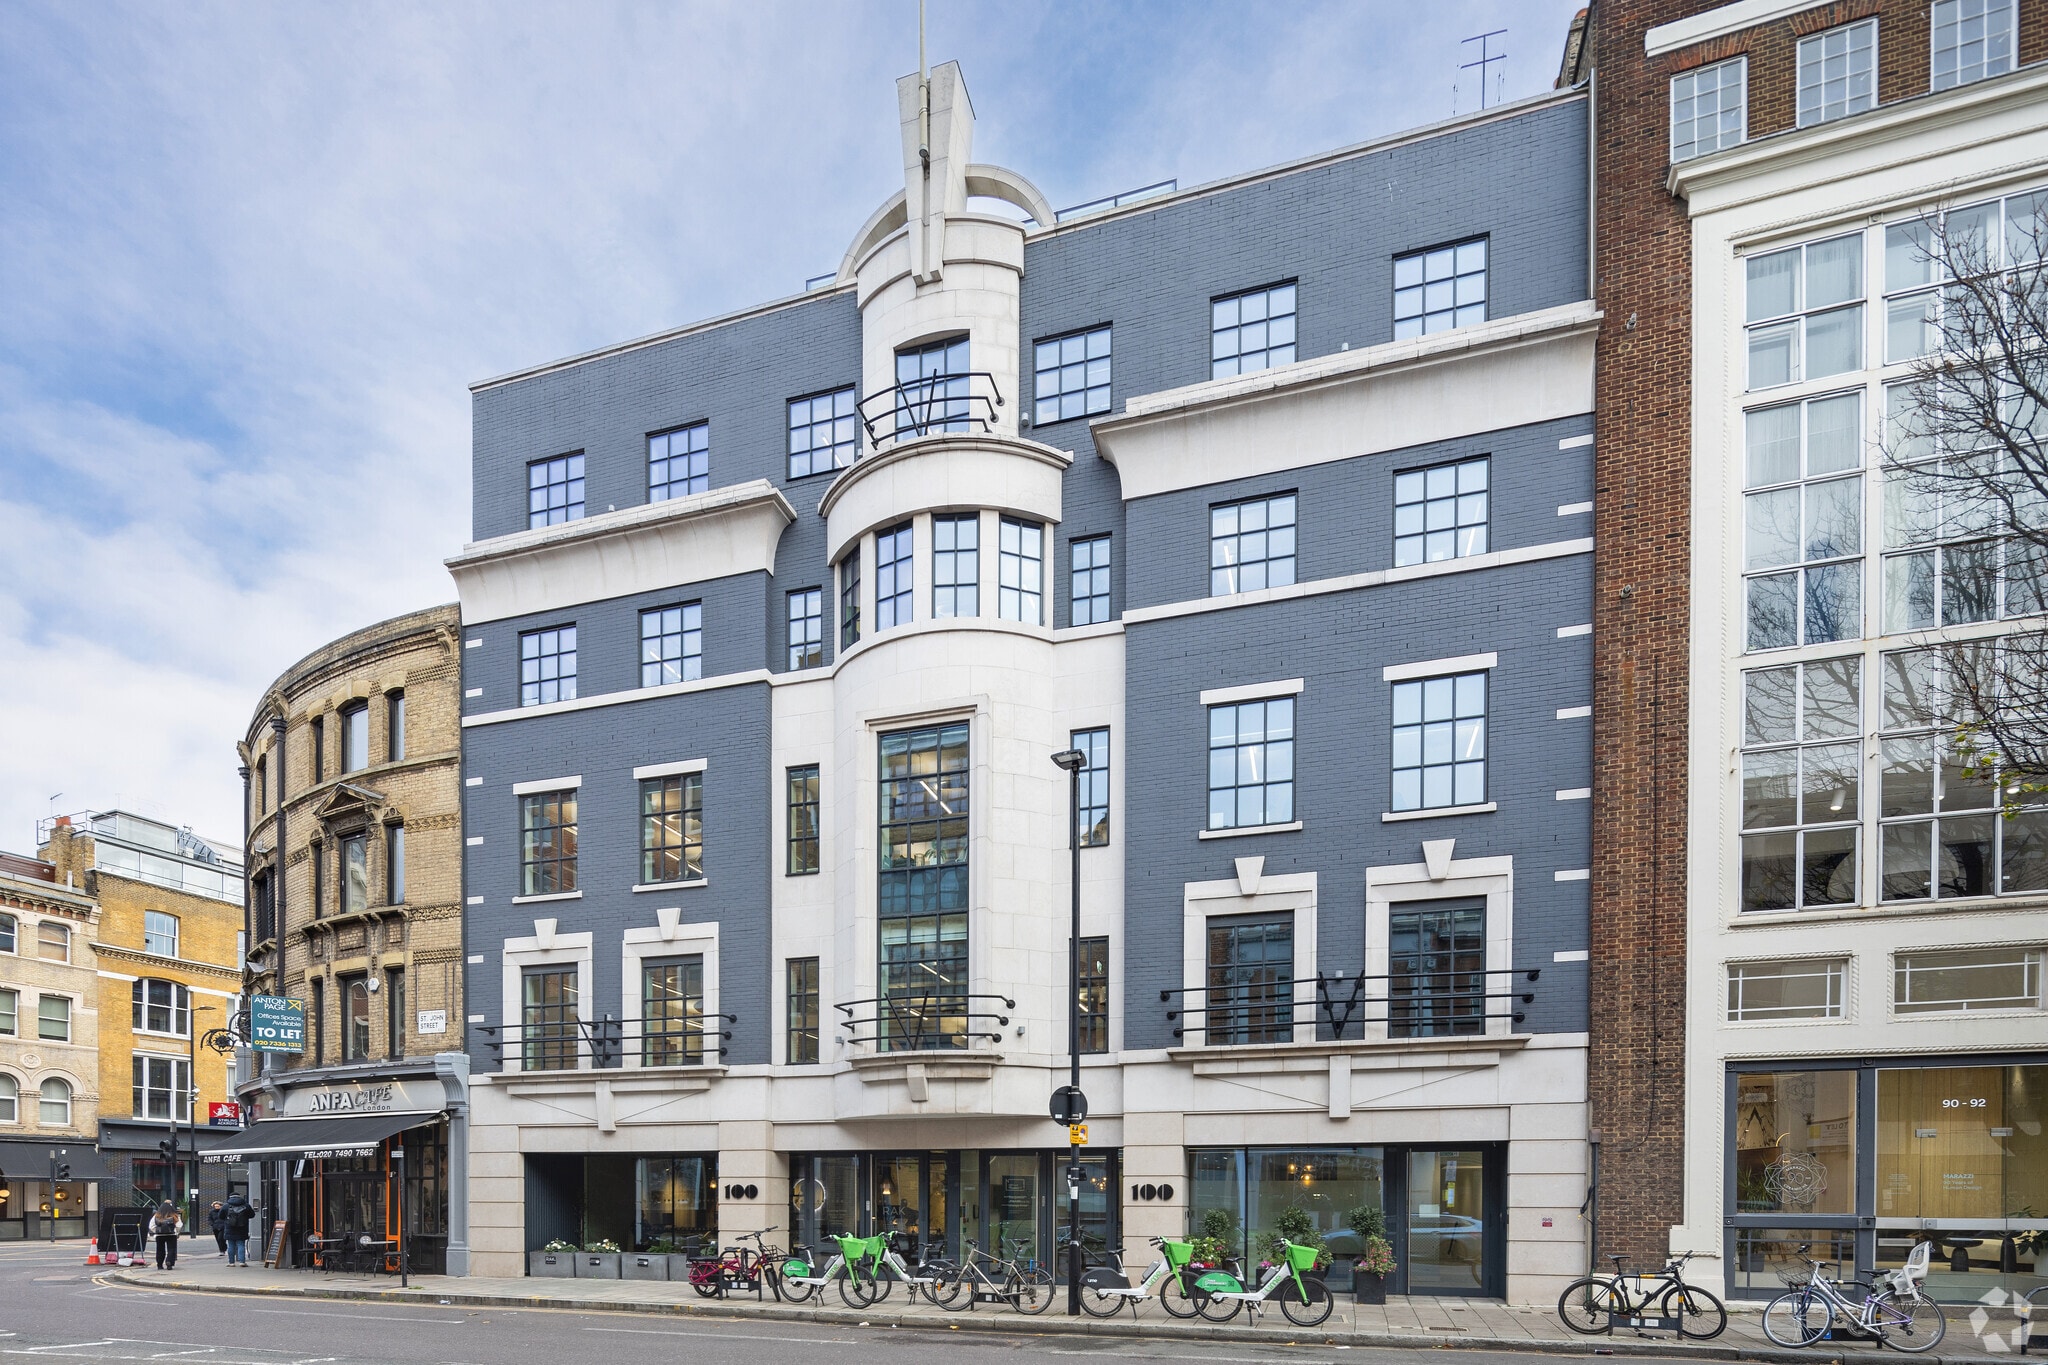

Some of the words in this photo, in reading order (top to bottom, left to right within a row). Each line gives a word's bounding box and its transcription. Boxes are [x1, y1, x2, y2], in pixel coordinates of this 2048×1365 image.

[254, 997, 286, 1005] ANTON
[256, 1027, 276, 1038] TO
[280, 1028, 302, 1039] LET
[309, 1091, 354, 1112] ANFA
[1942, 1099, 1959, 1108] 90
[1969, 1098, 1986, 1108] 92
[335, 1149, 353, 1158] 7490
[356, 1148, 374, 1157] 7662
[203, 1155, 221, 1164] ANFA
[223, 1154, 242, 1162] CAFE
[724, 1184, 758, 1200] 100
[1131, 1183, 1174, 1201] 100
[882, 1206, 906, 1215] RAK
